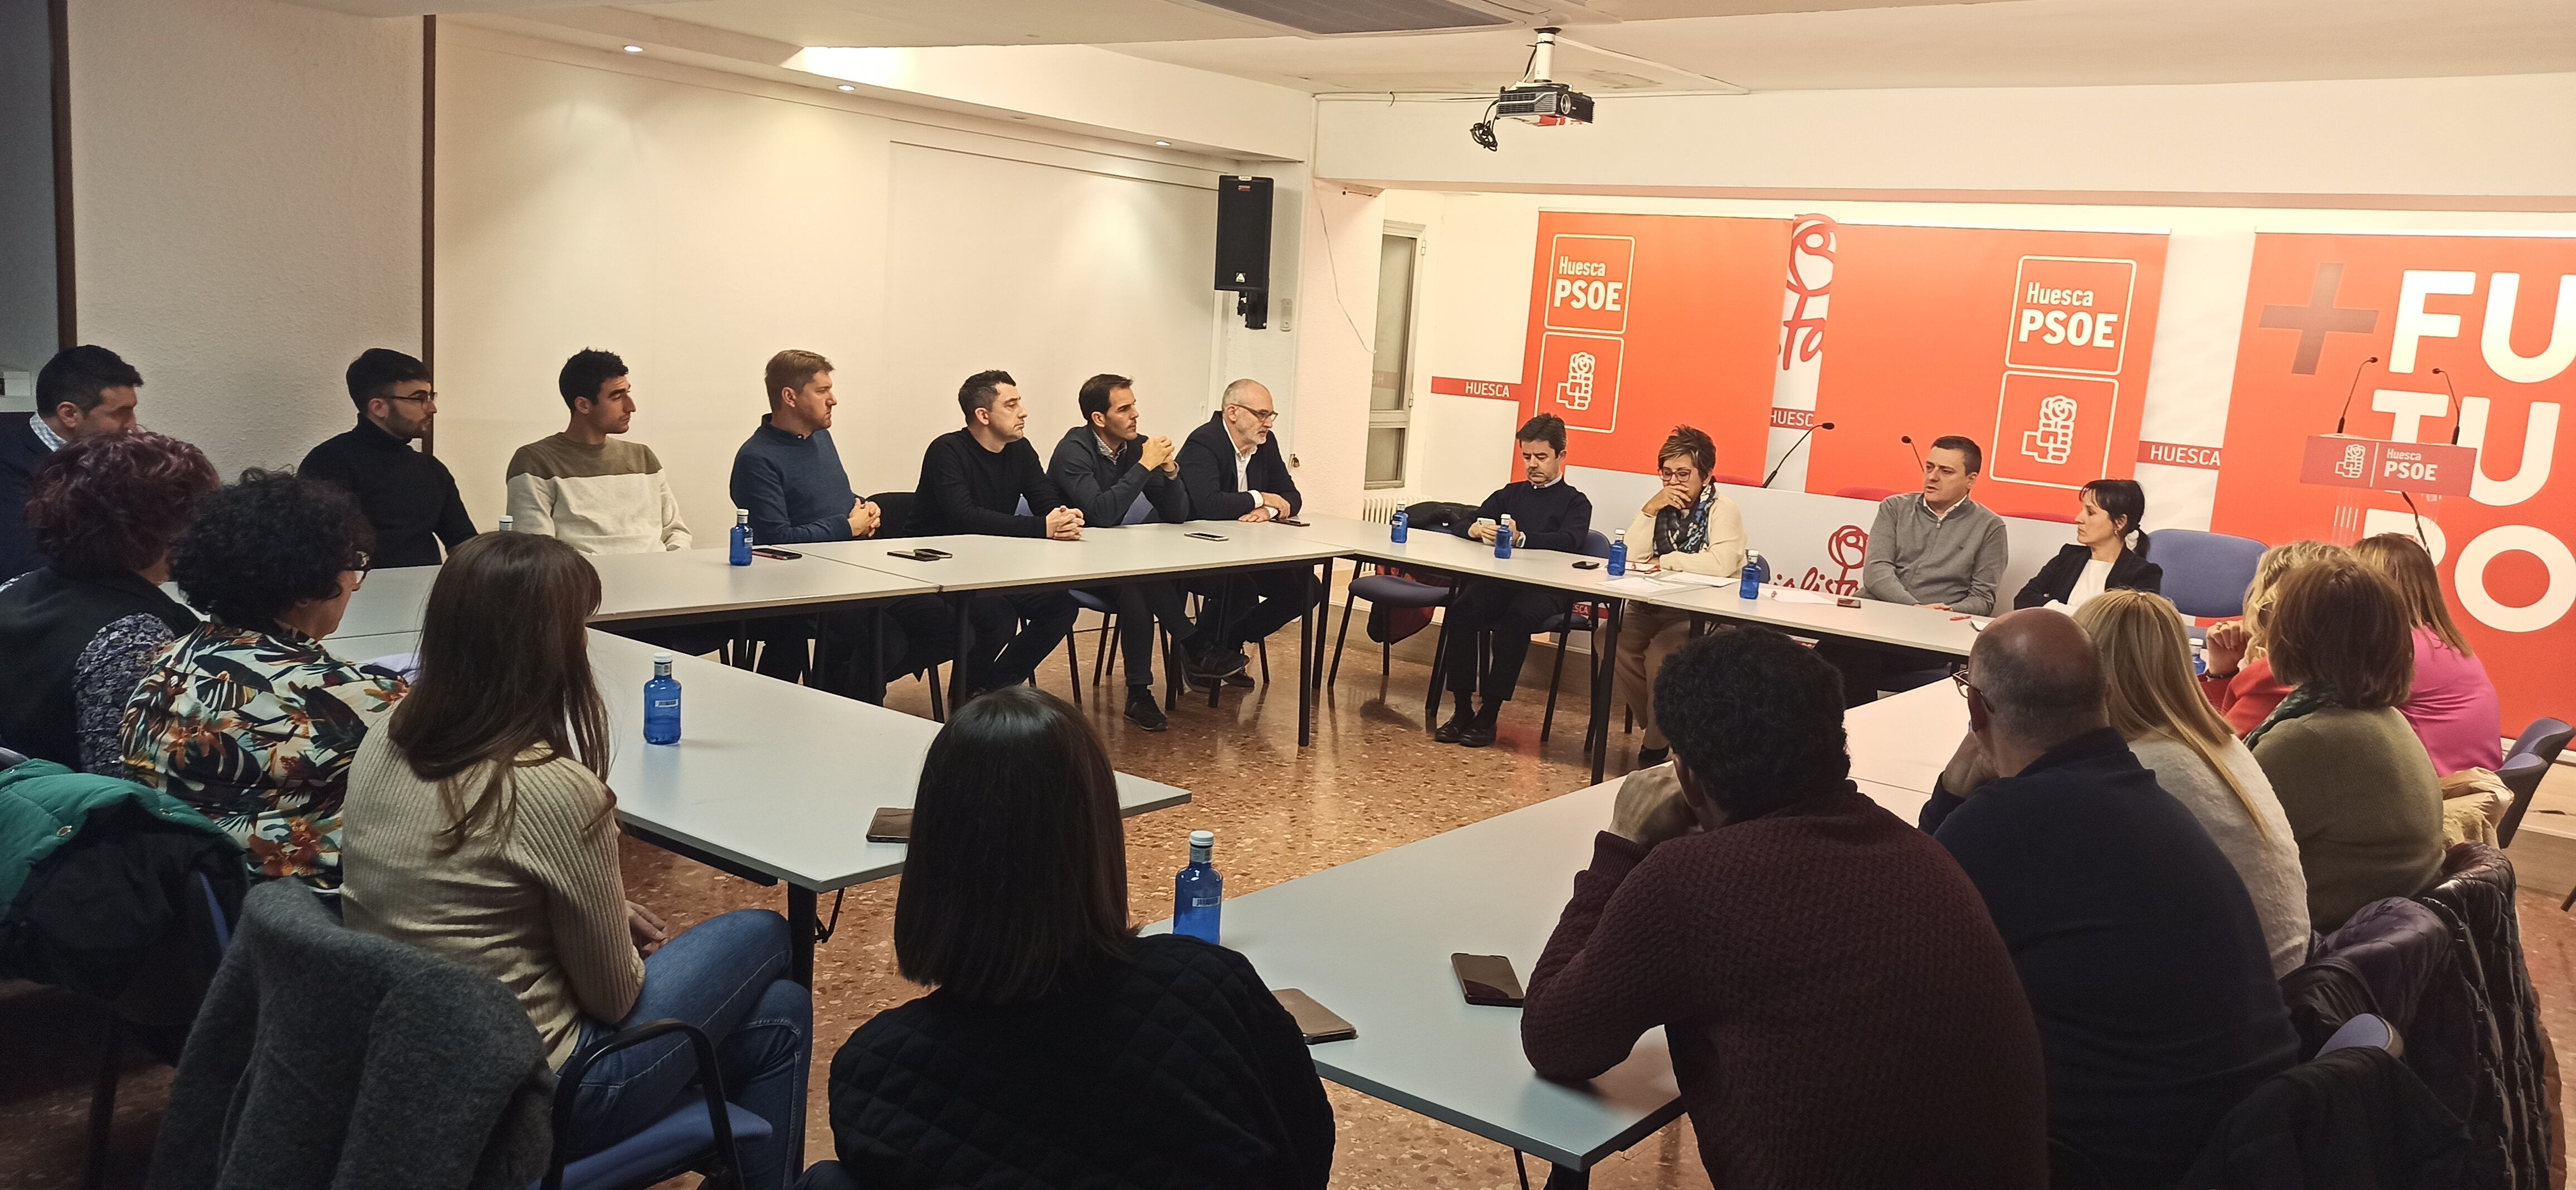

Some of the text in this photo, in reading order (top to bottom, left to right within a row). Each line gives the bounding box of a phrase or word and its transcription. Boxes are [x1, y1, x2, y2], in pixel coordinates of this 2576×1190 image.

[1559, 255, 1606, 277] Huesca
[1553, 278, 1623, 311] PSOE
[2026, 282, 2094, 306] Huesca
[2018, 309, 2118, 348] PSOE
[2388, 270, 2576, 383] FU
[1465, 382, 1509, 398] HUESCA
[2150, 445, 2221, 466] HUESCA
[2372, 389, 2561, 506] TU
[2387, 448, 2421, 461] Huesca
[2384, 461, 2438, 481] PSOE
[1573, 603, 1588, 614] SCA
